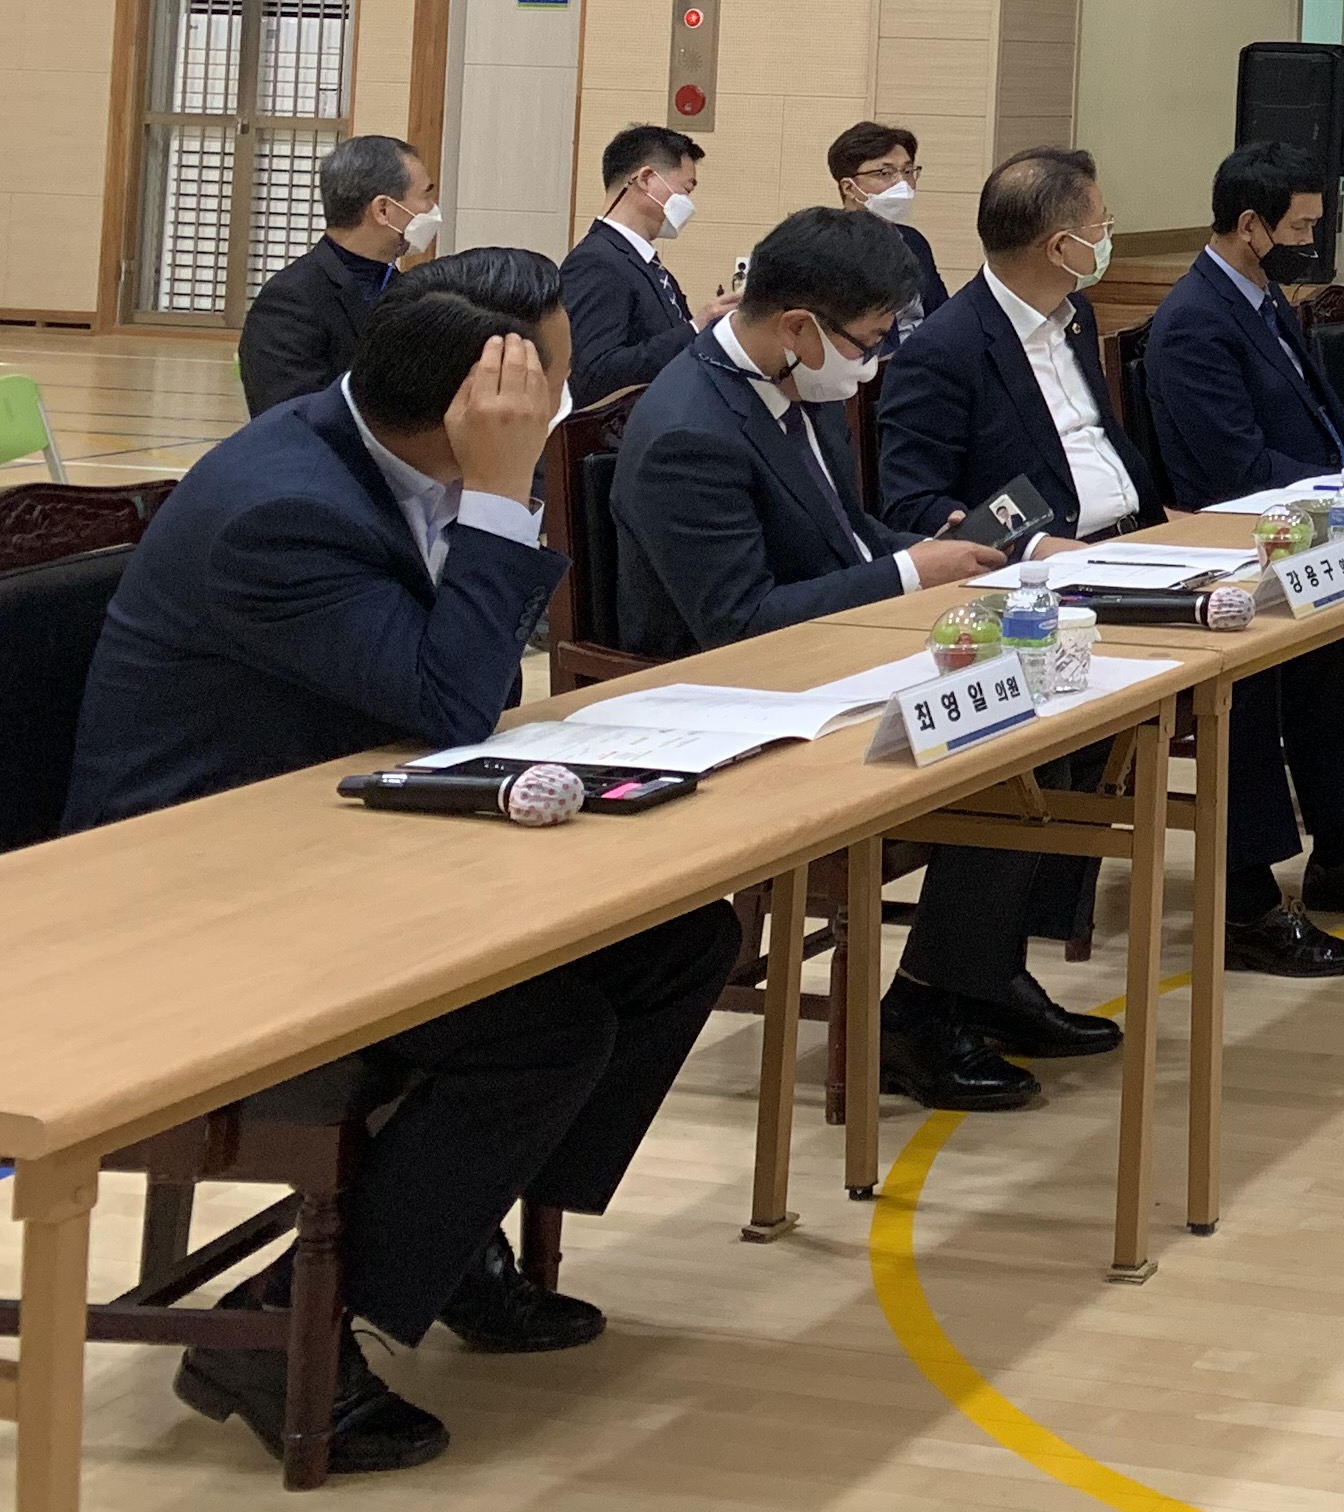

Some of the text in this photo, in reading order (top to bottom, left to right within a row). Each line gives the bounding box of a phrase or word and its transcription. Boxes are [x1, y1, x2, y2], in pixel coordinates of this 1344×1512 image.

[1286, 559, 1334, 594] 강용구
[914, 675, 1021, 732] 최영일 의원
